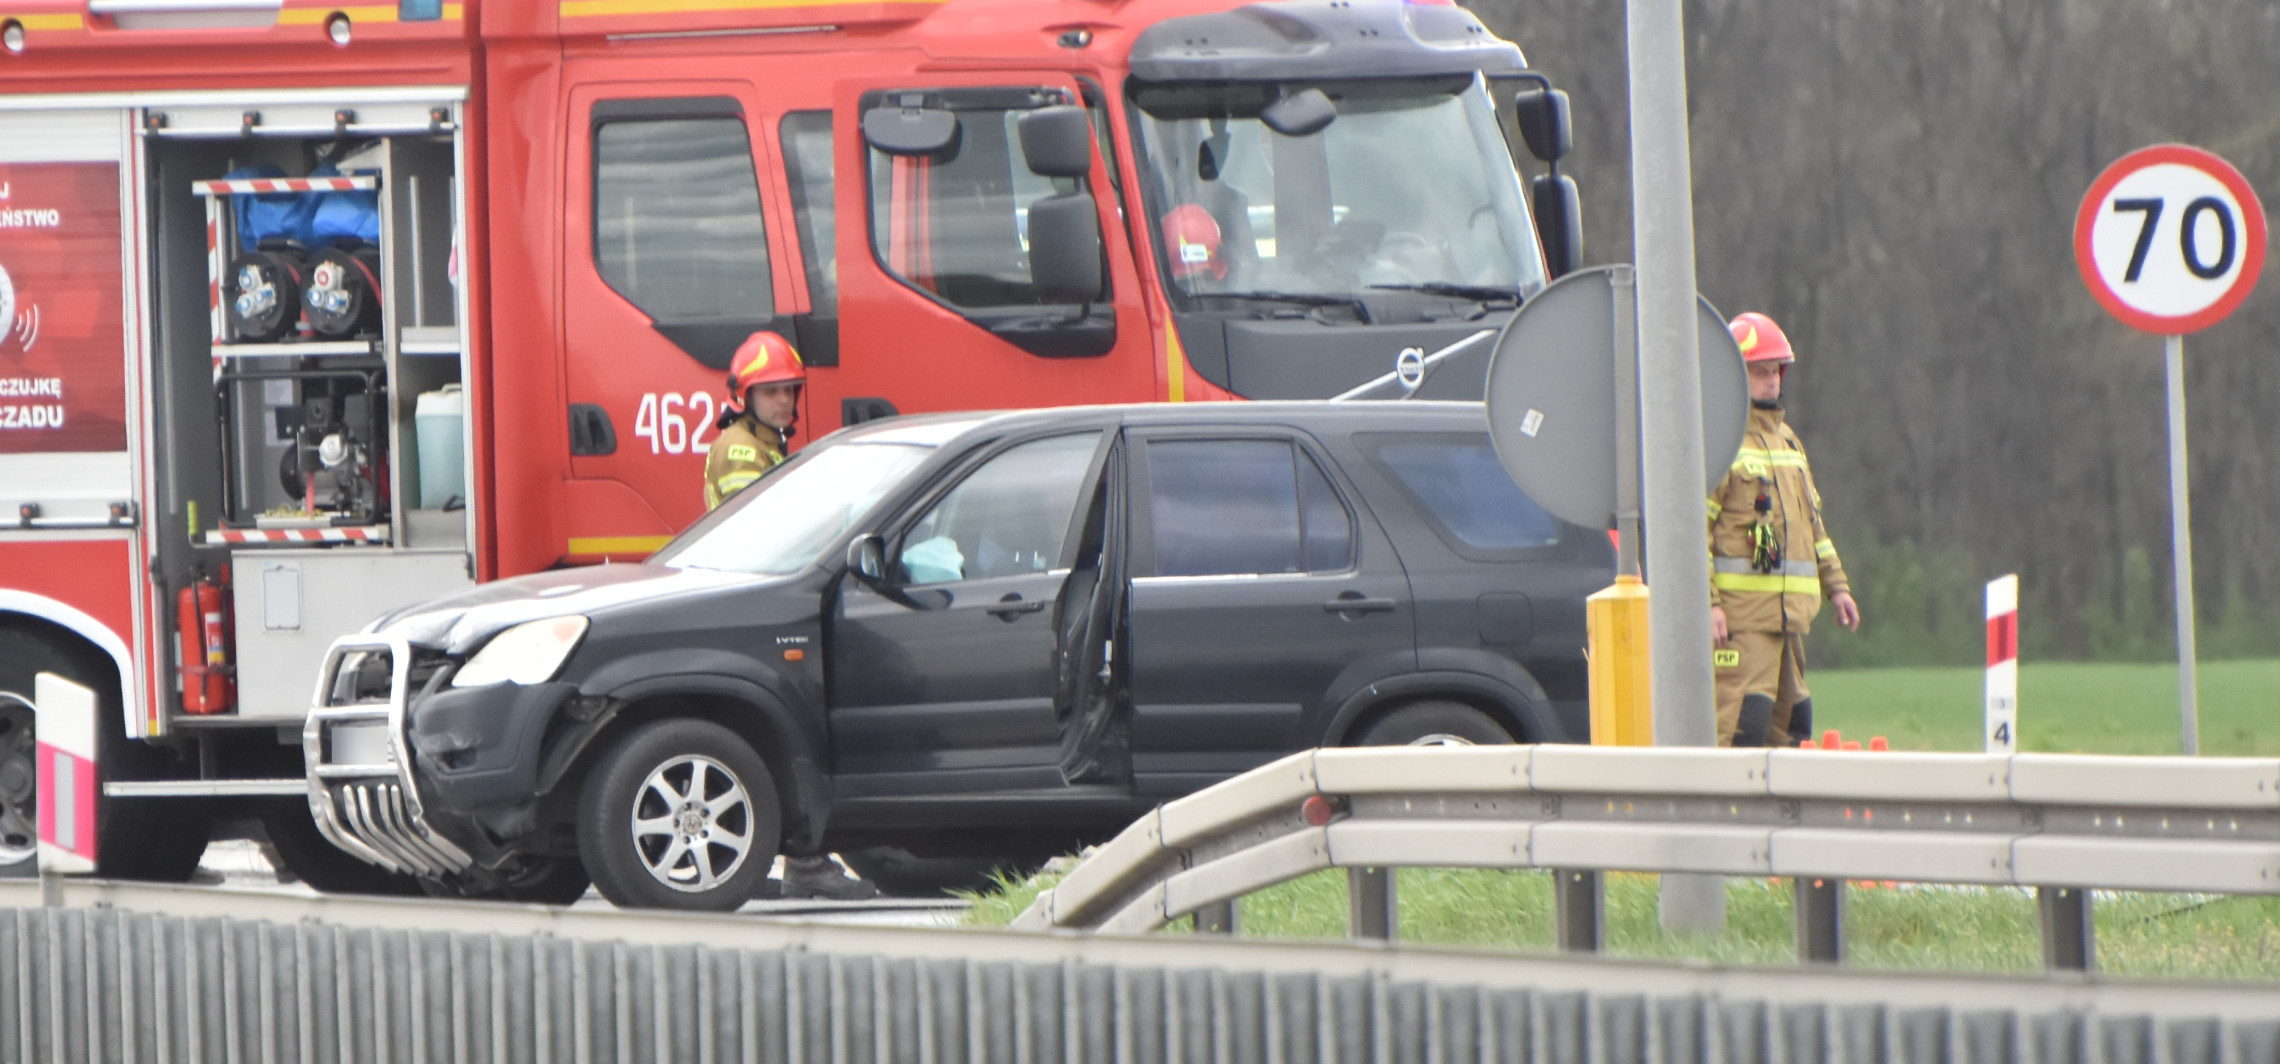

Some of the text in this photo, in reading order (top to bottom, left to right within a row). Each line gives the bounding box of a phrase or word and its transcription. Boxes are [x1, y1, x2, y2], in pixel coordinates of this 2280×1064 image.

[0, 206, 60, 227] ŃSTWO
[2113, 195, 2236, 283] 70
[0, 405, 63, 428] ZADU
[634, 391, 727, 454] 462
[1717, 653, 1735, 663] PSP
[1994, 721, 2010, 746] 4
